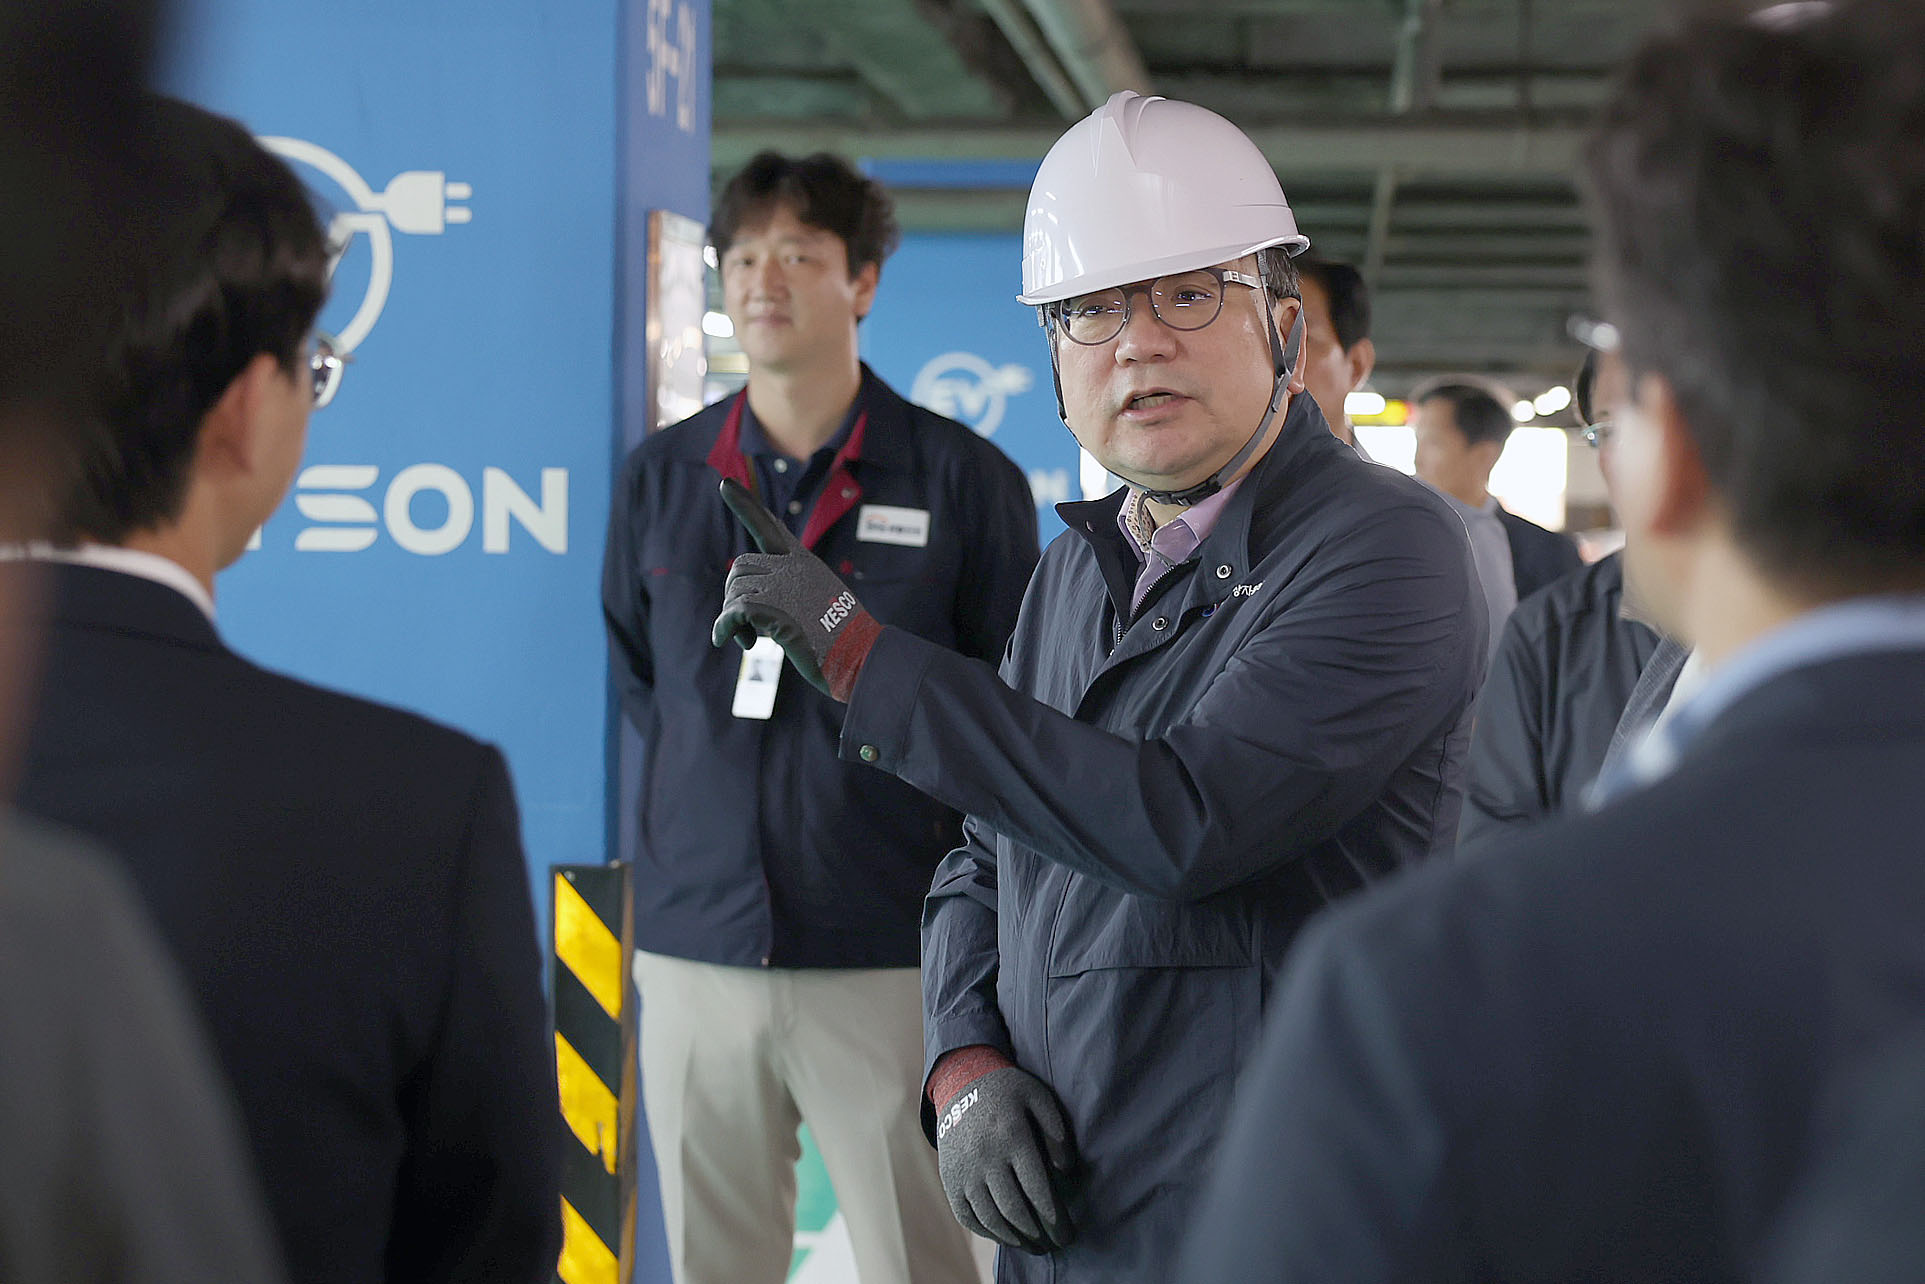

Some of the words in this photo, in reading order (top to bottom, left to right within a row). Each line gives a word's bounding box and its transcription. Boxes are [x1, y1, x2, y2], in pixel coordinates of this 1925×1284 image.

[245, 463, 568, 556] SON
[820, 591, 856, 632] KESCO
[939, 1088, 979, 1139] KESCO
